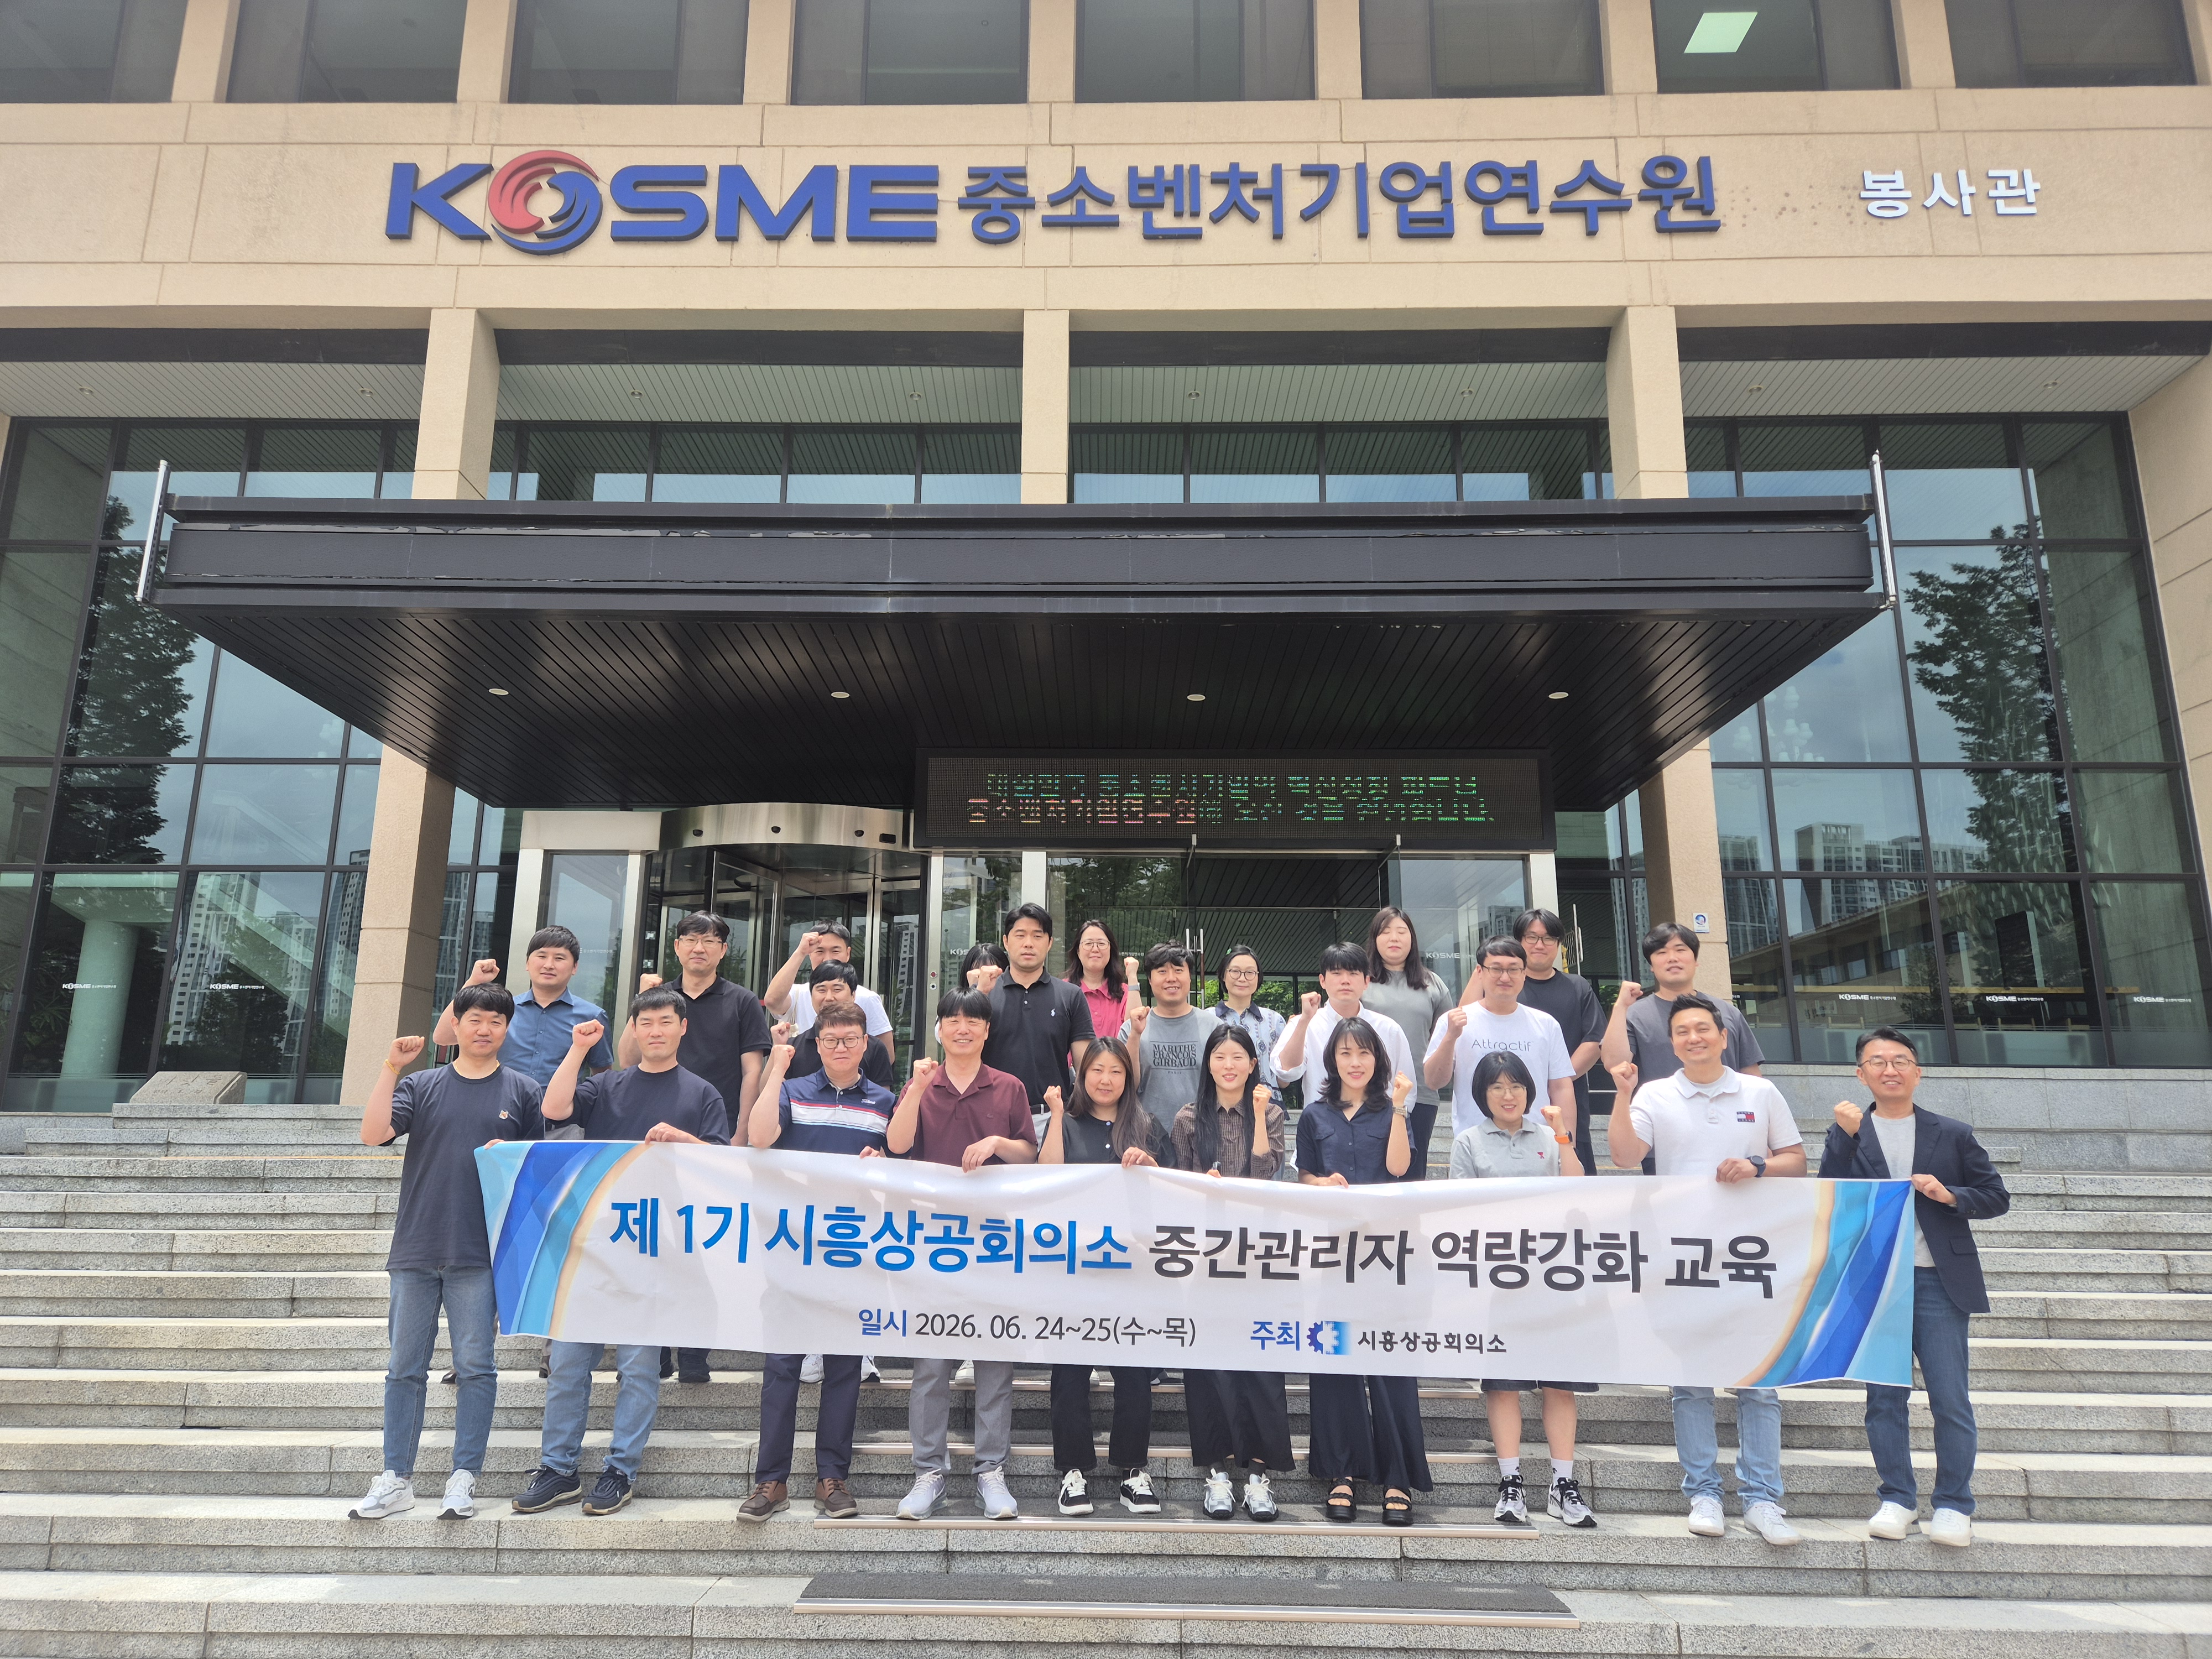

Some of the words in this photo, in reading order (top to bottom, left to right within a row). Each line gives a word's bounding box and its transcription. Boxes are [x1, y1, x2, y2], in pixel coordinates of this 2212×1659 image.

[384, 149, 940, 255] KOSME
[958, 155, 1721, 243] 중소벤처기업연수원
[1860, 169, 2041, 218] 봉사관
[1472, 1039, 1531, 1052] Attractif
[1153, 1058, 1197, 1067] GIRBAUD
[611, 1198, 659, 1258] 제
[677, 1203, 749, 1264] 1기
[765, 1206, 1132, 1275] 시흥상공회의소
[1150, 1227, 1415, 1285] 중간관리자
[1433, 1230, 1648, 1293] 역량강화
[1666, 1237, 1777, 1299] 교육
[859, 1310, 907, 1337] 일시
[916, 1314, 982, 1339] 2026.
[991, 1316, 1026, 1339] 06.
[1035, 1317, 1196, 1347] 24~25(수~목)
[1251, 1322, 1300, 1351] 주최
[1358, 1331, 1507, 1354] 시흥상공회의소
